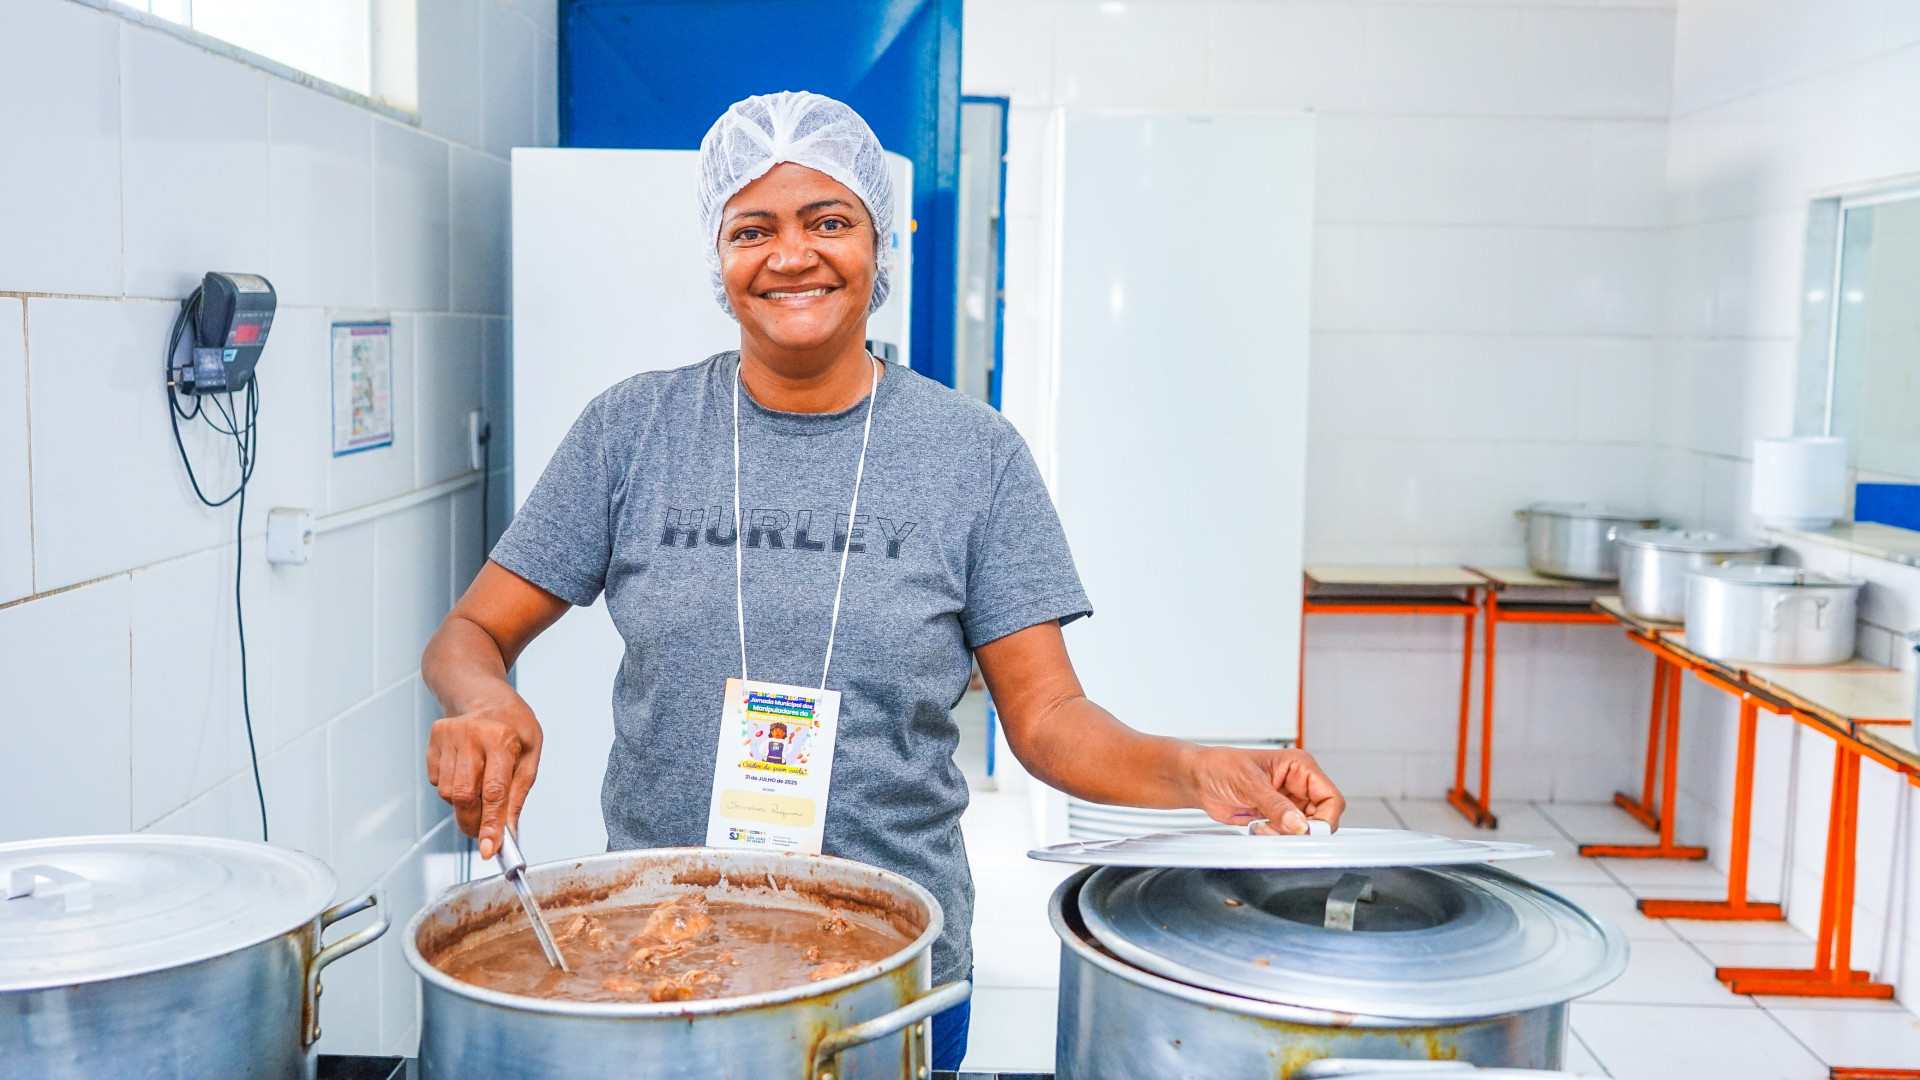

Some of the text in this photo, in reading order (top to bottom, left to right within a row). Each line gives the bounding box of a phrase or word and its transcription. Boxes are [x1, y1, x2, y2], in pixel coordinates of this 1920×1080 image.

[660, 505, 918, 559] HURLEY
[775, 700, 802, 709] Municipal
[753, 705, 799, 715] Manipuladores
[729, 831, 747, 841] SJM
